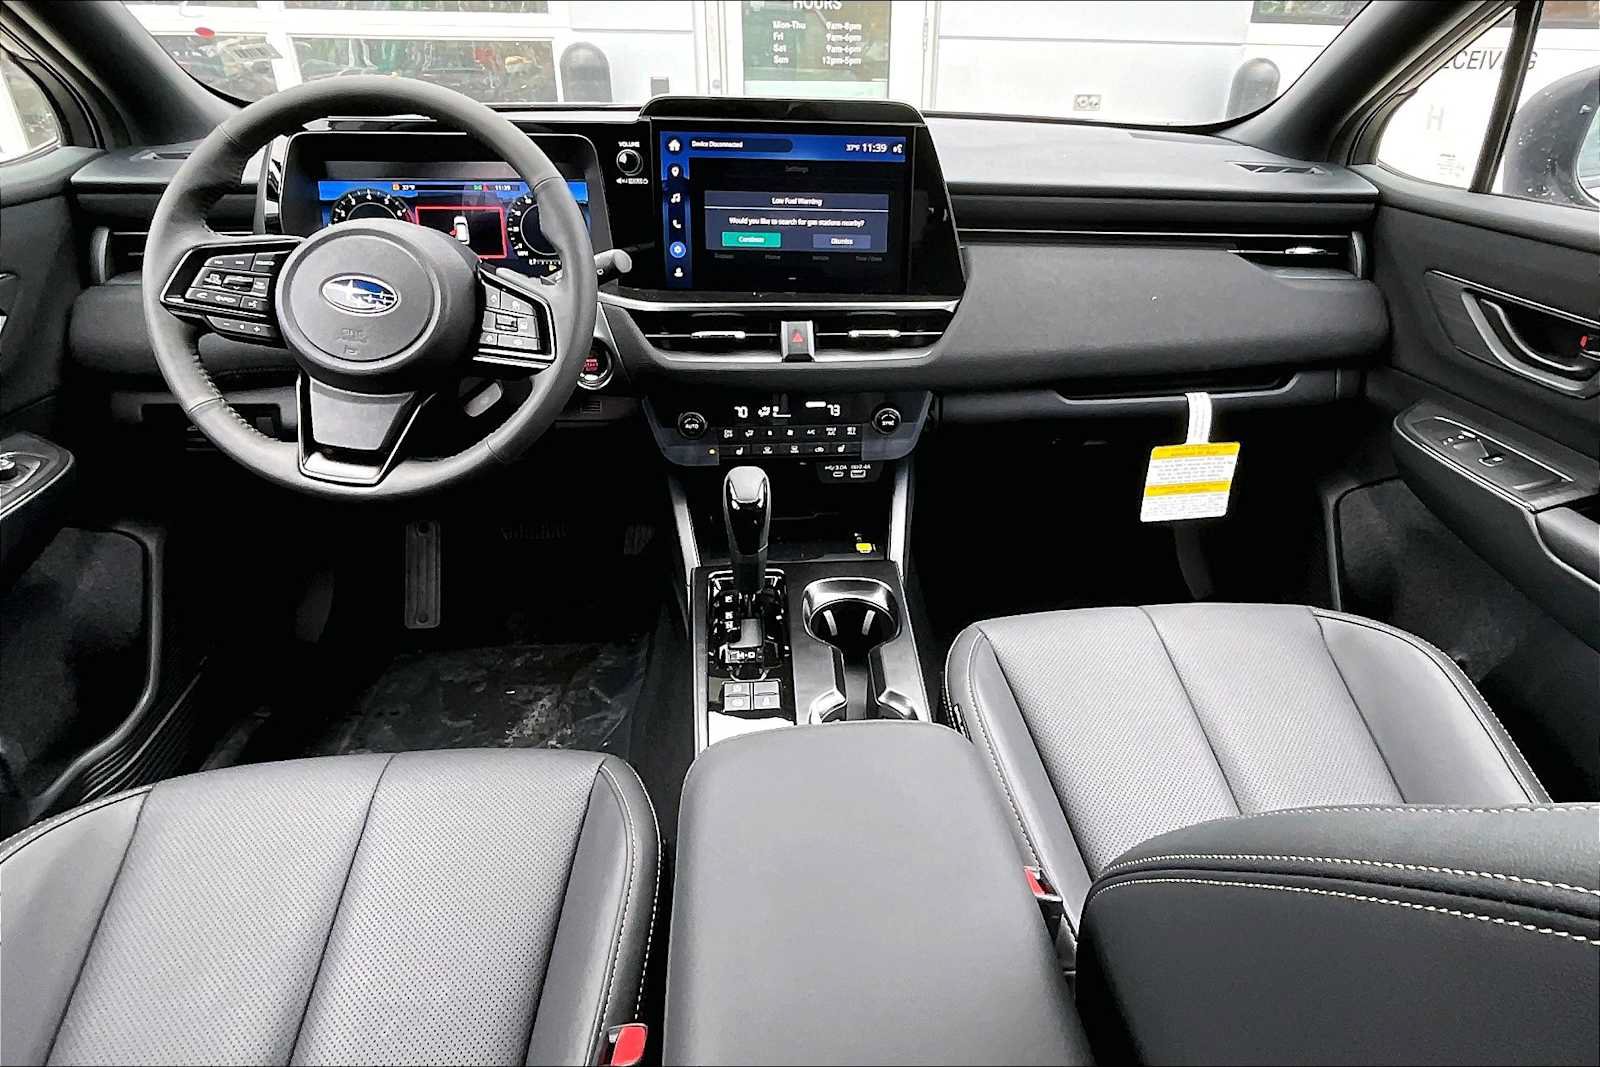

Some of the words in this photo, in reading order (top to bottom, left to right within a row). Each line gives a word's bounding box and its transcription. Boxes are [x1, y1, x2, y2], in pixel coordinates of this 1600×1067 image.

[792, 1, 842, 9] HOURS
[772, 21, 806, 29] Mon-Thu
[773, 31, 784, 40] Fri
[773, 43, 787, 52] Sat
[773, 55, 789, 64] Sun
[862, 143, 888, 152] 11:39
[784, 197, 798, 205] Fuel
[797, 198, 823, 207] Warning
[747, 218, 760, 226] you
[807, 220, 818, 228] gas
[842, 220, 865, 228] nearby?
[734, 406, 748, 418] 70
[827, 404, 840, 416] 73
